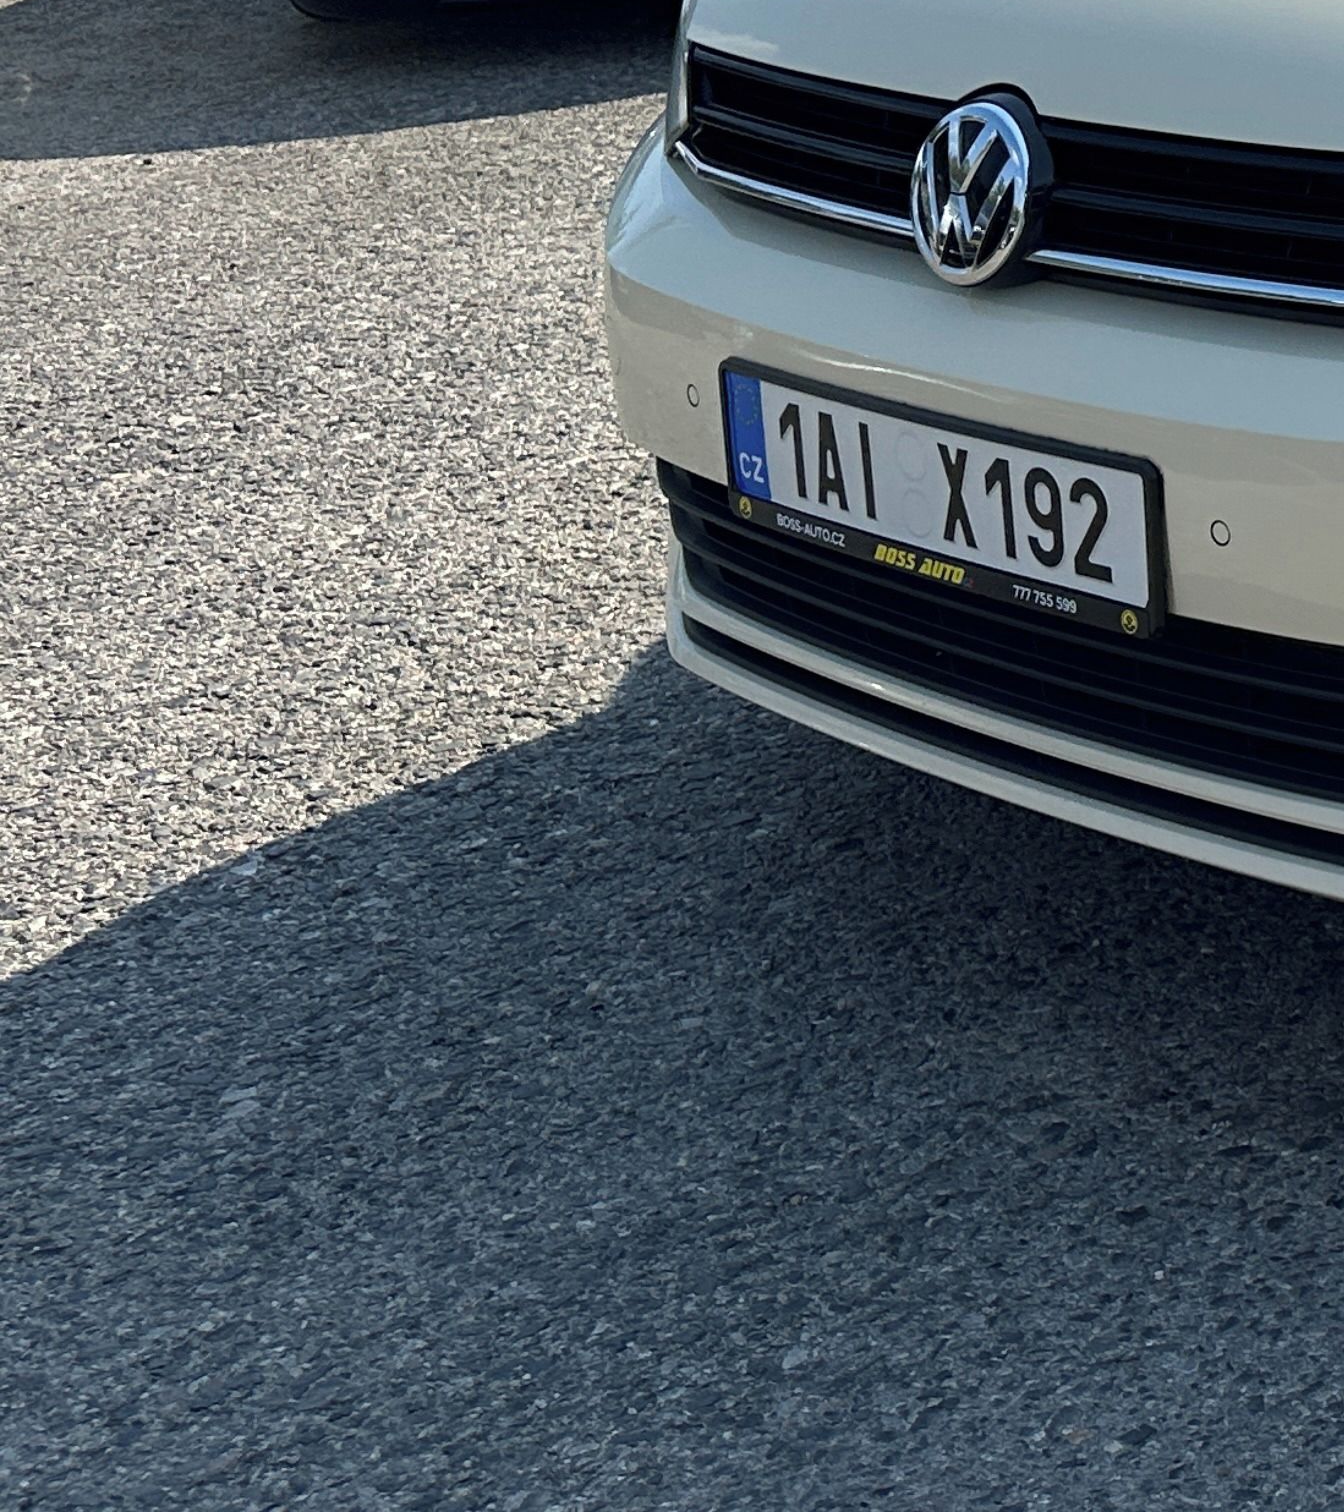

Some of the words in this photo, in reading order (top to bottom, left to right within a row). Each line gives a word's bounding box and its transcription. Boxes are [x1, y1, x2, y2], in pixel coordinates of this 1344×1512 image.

[739, 452, 765, 483] CZ
[778, 402, 878, 521] 1AI
[937, 441, 1114, 584] X192
[776, 513, 846, 548] BOSS-AUTO.CZ
[874, 543, 916, 571] BOSS
[918, 558, 966, 585] AUTO
[1012, 584, 1033, 601] 777
[1033, 588, 1054, 608] 755
[1055, 592, 1078, 614] 599
